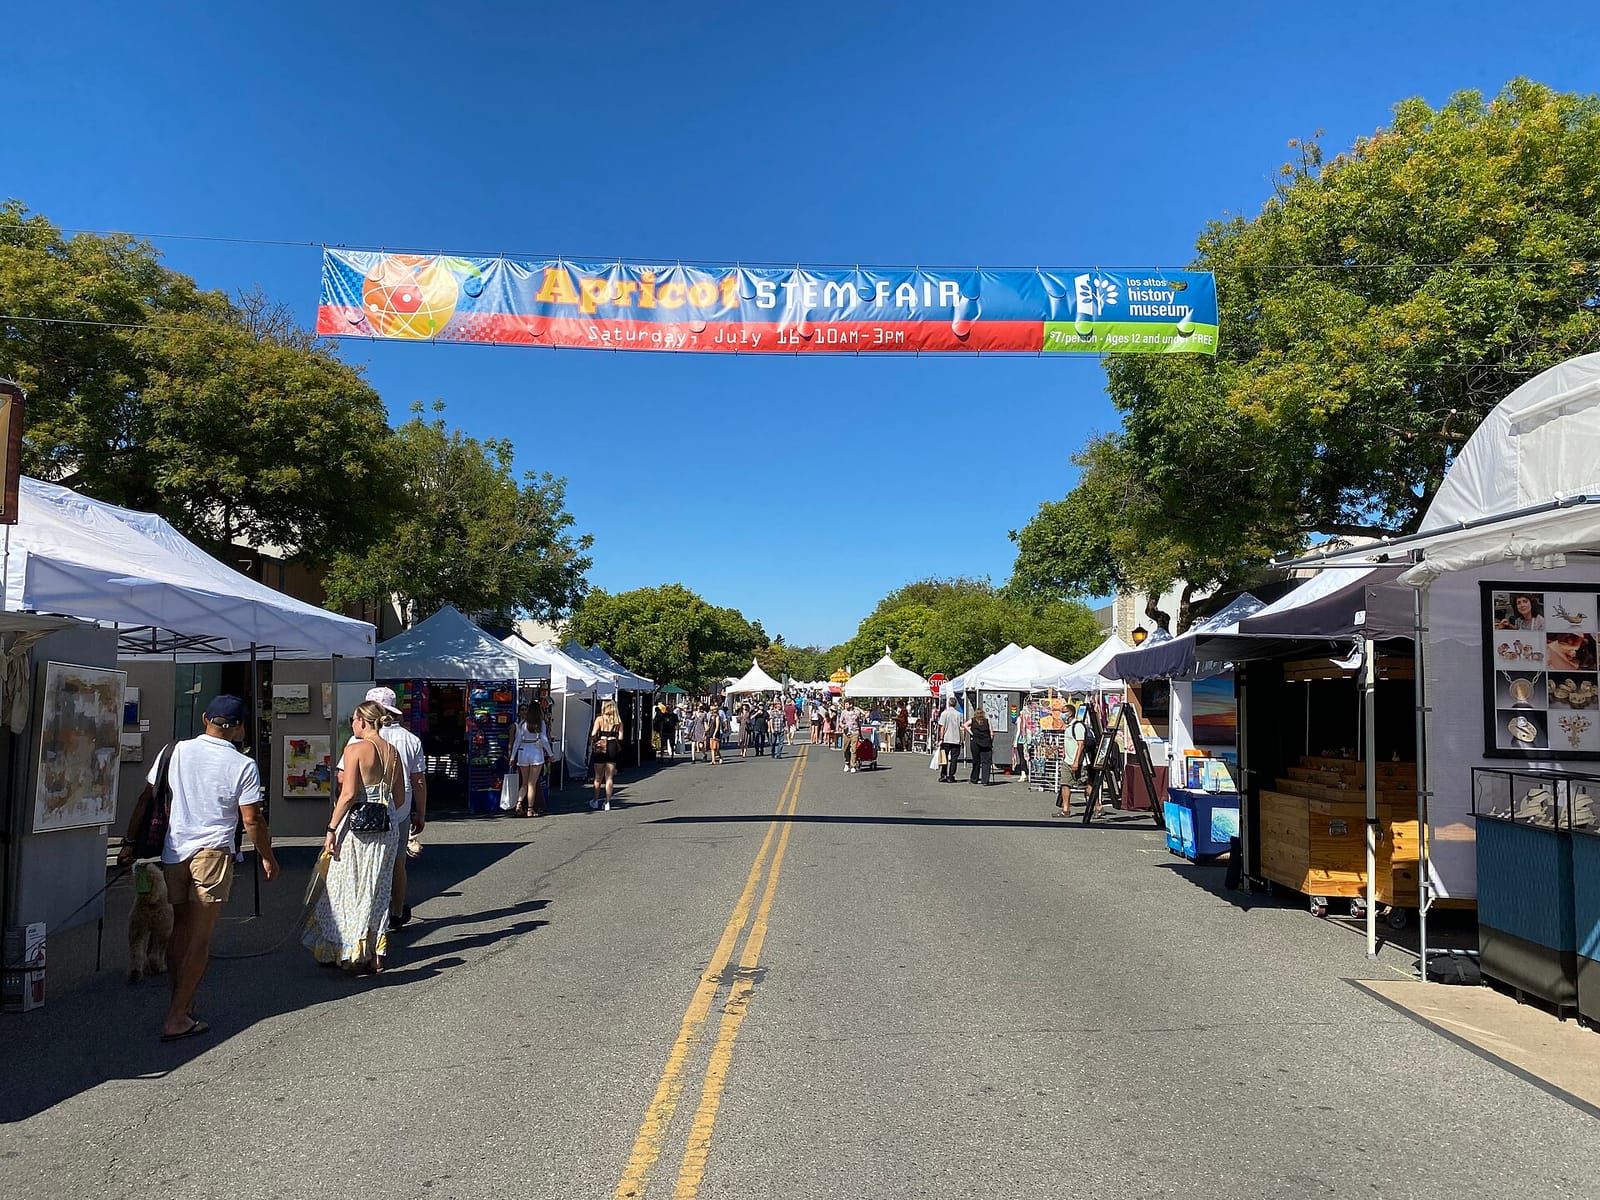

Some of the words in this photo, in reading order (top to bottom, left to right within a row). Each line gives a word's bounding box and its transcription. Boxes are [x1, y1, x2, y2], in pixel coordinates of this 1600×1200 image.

[1126, 277, 1140, 287] los
[1143, 278, 1167, 287] altos
[535, 267, 741, 314] Apricot
[756, 281, 857, 309] STEM
[875, 281, 960, 307] FAIR
[1127, 288, 1175, 304] history
[1129, 303, 1189, 317] museum
[588, 327, 698, 346] Saturday,
[714, 328, 762, 346] July
[777, 328, 799, 344] 16
[815, 328, 904, 344] 10AM-3PM
[1105, 334, 1129, 344] Ages
[1131, 335, 1140, 344] 12
[1143, 335, 1163, 344] and
[1164, 335, 1189, 345] und
[1192, 335, 1213, 345] FREE
[930, 679, 946, 687] STOP
